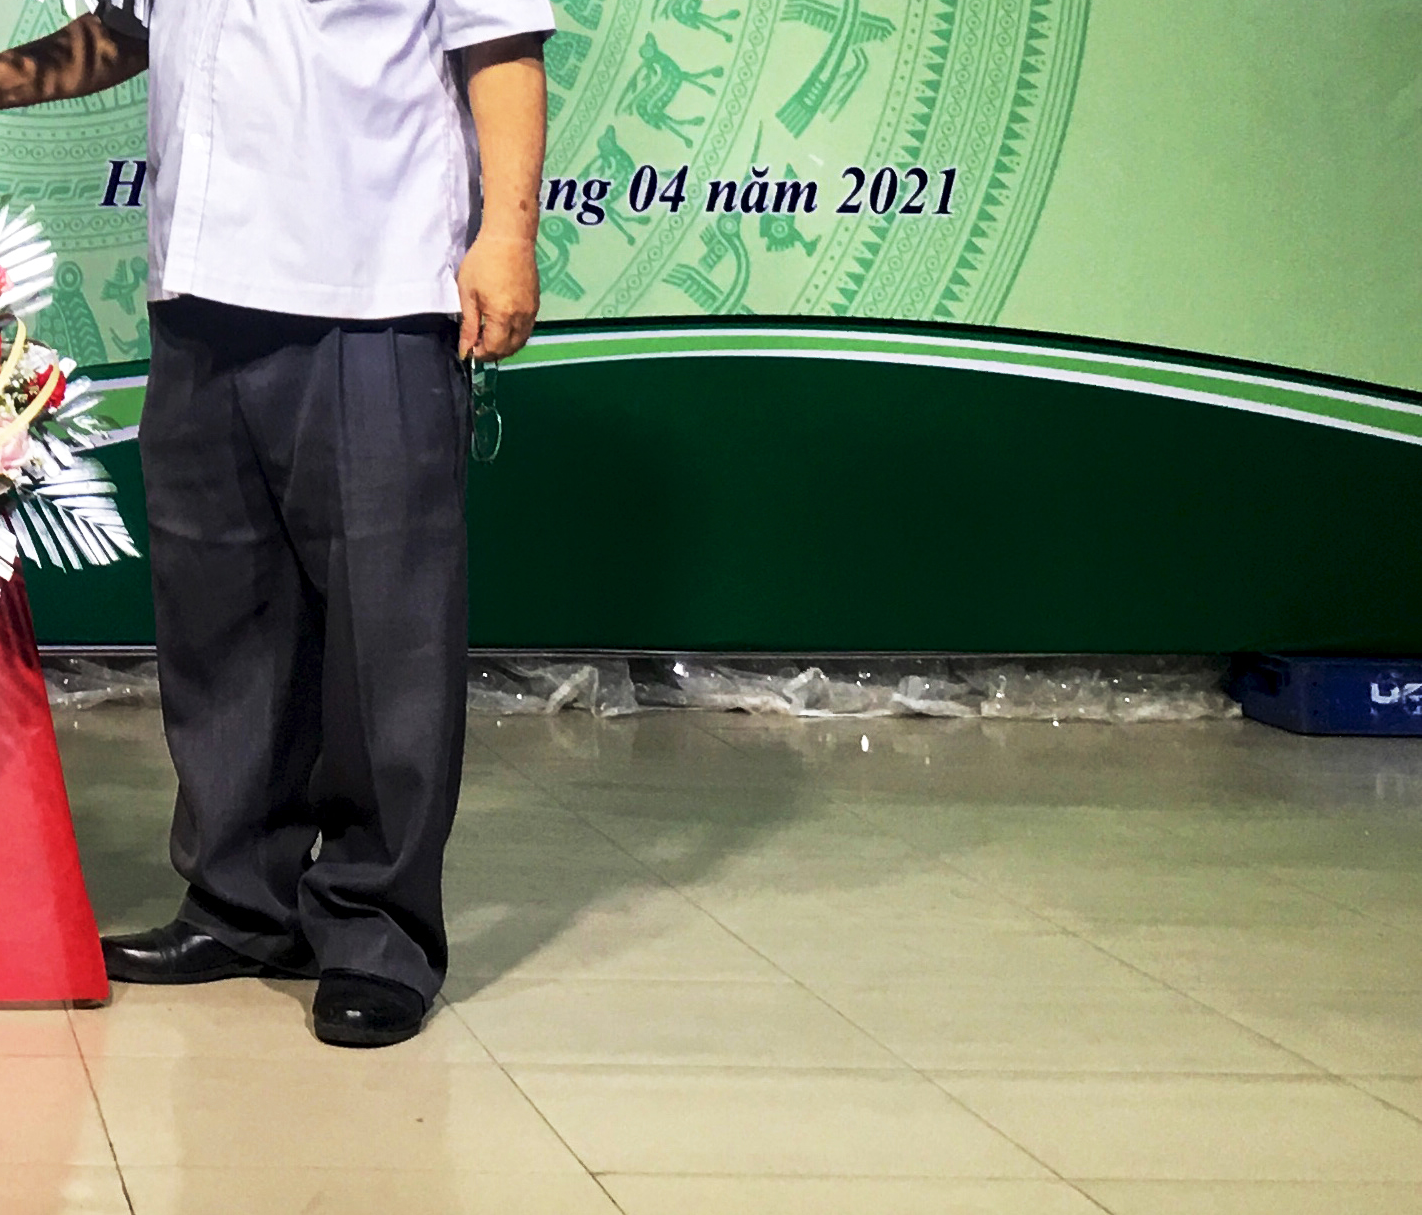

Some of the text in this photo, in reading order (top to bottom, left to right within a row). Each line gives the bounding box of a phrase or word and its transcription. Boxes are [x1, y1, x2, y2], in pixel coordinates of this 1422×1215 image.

[629, 164, 689, 213] 04
[705, 166, 818, 214] năm
[836, 167, 956, 215] 2021
